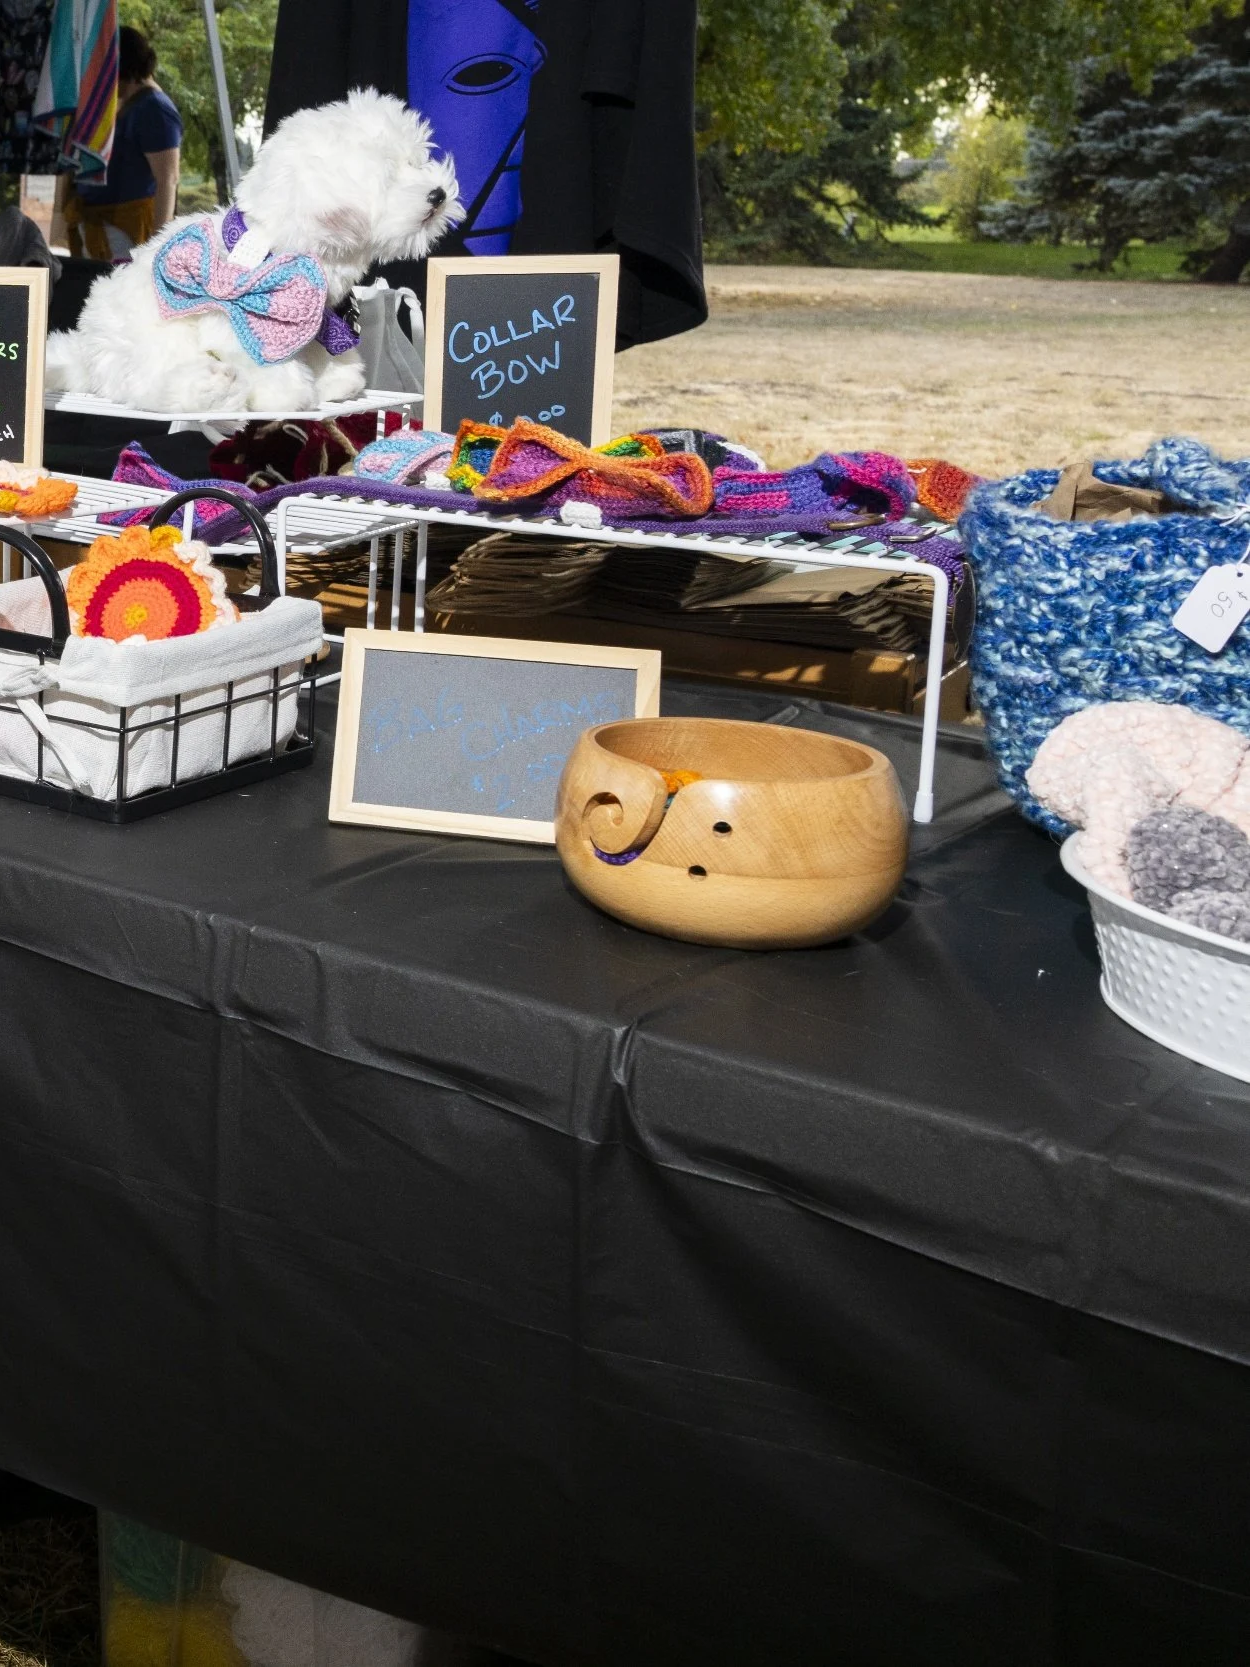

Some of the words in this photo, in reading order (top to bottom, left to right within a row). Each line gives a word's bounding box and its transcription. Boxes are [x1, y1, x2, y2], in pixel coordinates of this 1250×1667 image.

[448, 295, 576, 363] COLLAR
[470, 341, 560, 400] BOW
[1210, 590, 1248, 618] $50
